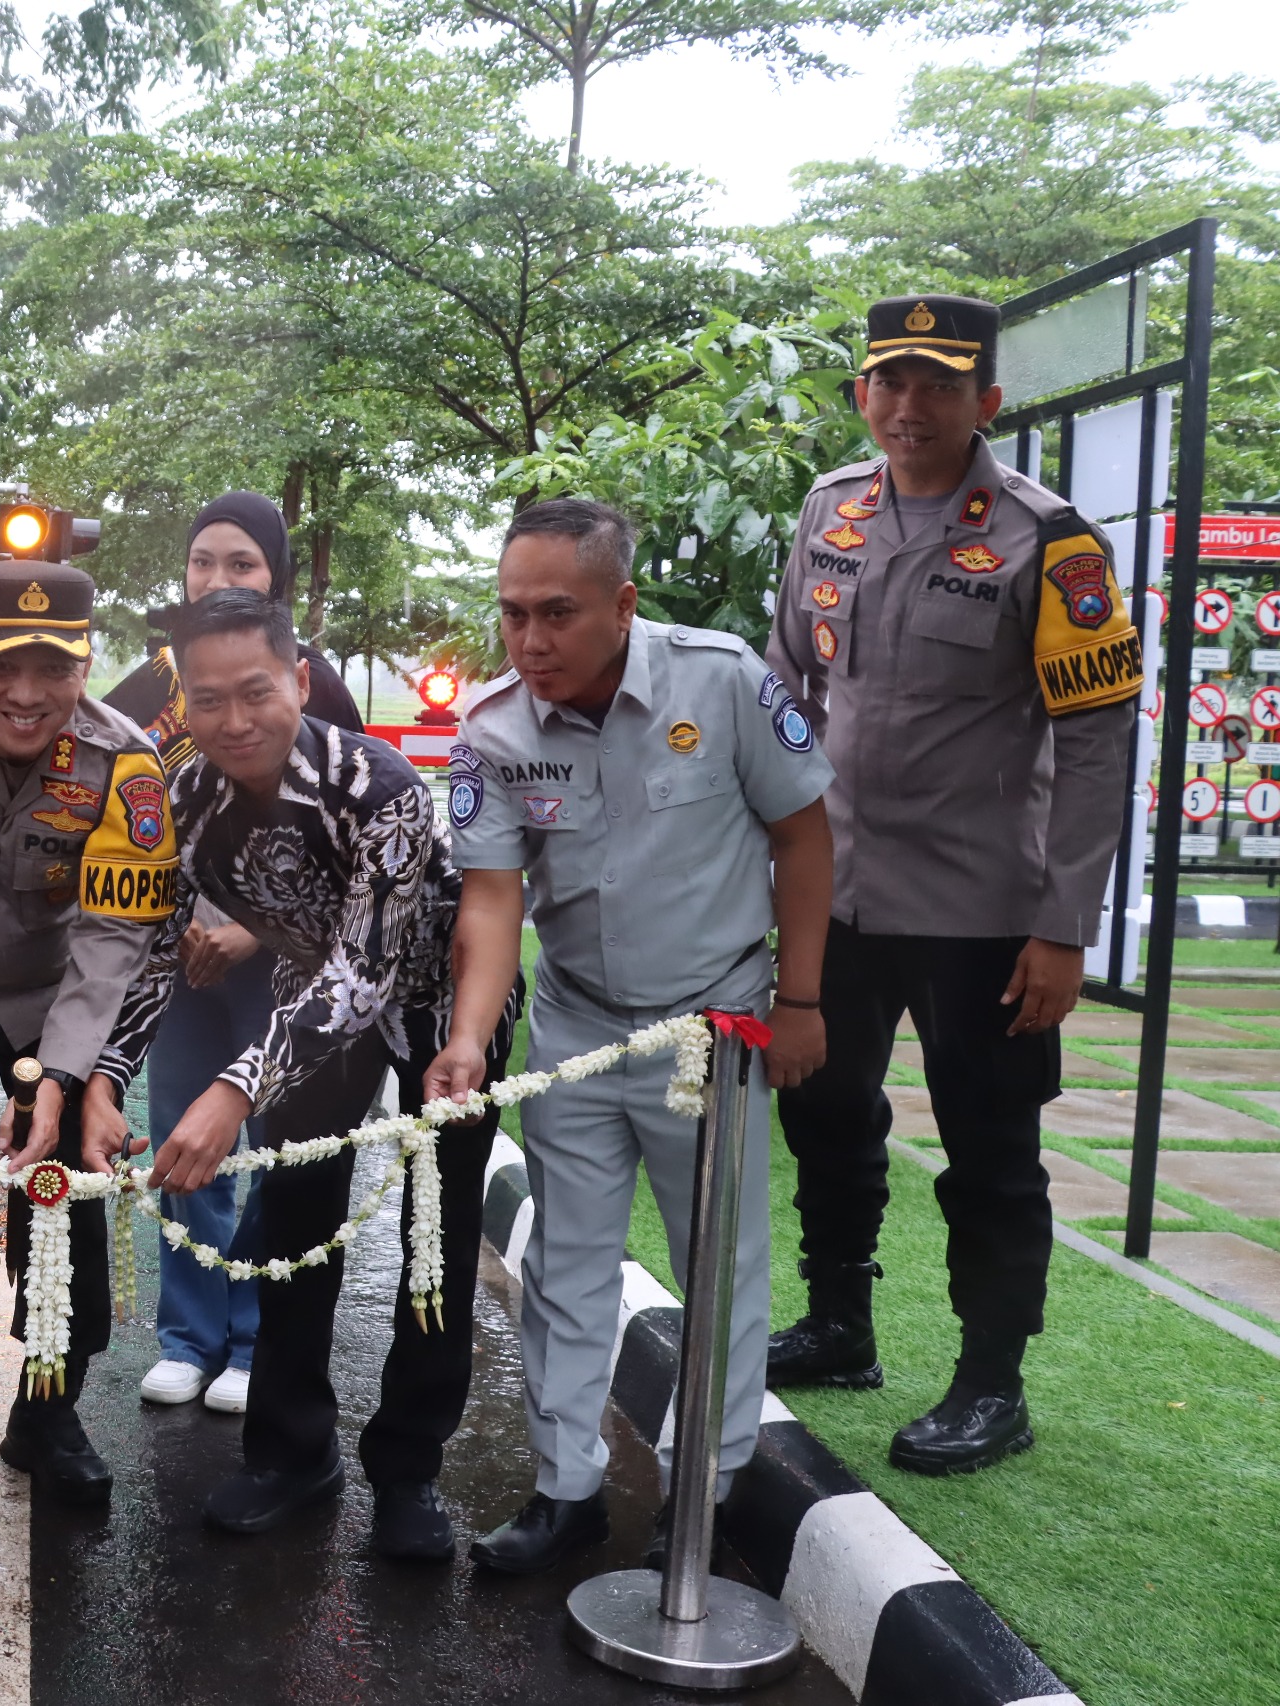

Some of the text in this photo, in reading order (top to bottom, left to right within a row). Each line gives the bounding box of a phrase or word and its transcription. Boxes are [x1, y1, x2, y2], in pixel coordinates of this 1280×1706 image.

[1199, 526, 1280, 546] ambu La
[810, 550, 862, 577] YOYOK
[1059, 560, 1100, 577] POLRES
[926, 573, 999, 603] POLRI
[500, 761, 574, 783] DANNY
[24, 833, 80, 856] POL
[84, 864, 177, 910] KAOPSRE
